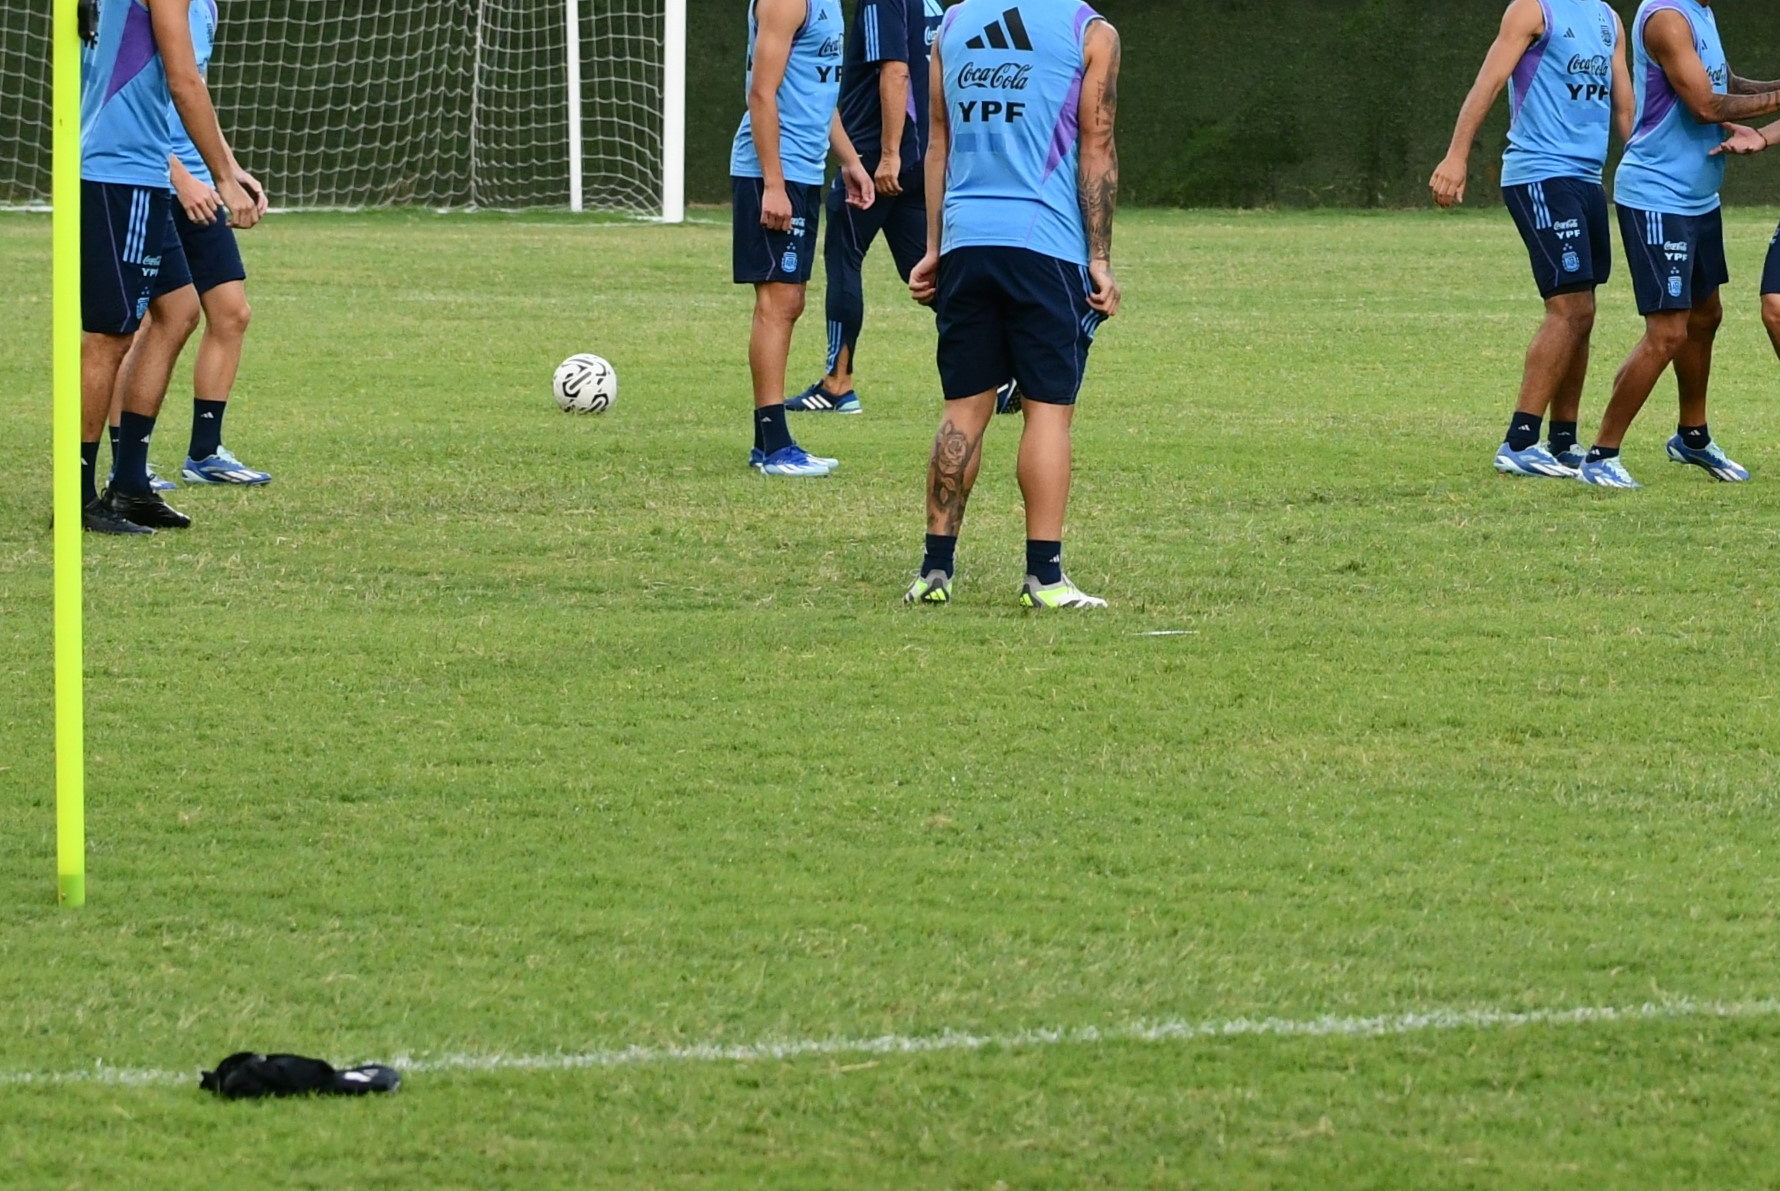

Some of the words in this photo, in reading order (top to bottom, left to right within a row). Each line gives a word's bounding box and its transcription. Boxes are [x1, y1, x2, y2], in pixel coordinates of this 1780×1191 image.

[815, 65, 843, 83] YP
[958, 61, 1033, 90] Coca-Cola
[958, 100, 1026, 124] YPF
[786, 228, 805, 238] PF
[1555, 229, 1581, 240] YPF
[1664, 251, 1688, 262] YPF
